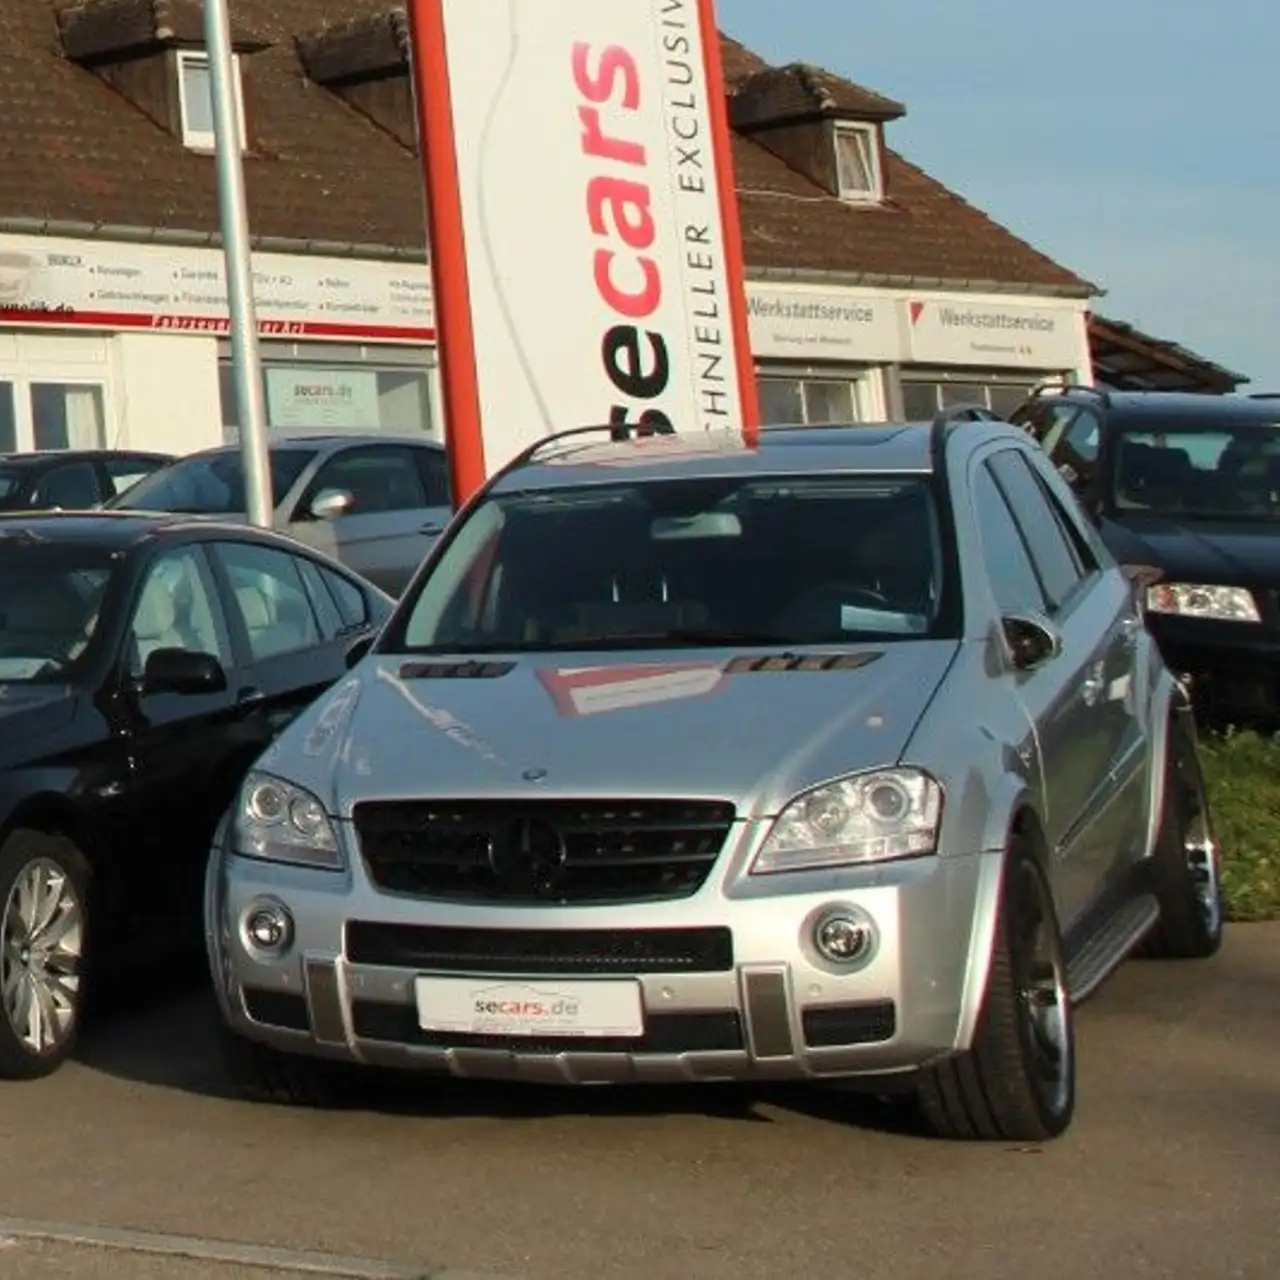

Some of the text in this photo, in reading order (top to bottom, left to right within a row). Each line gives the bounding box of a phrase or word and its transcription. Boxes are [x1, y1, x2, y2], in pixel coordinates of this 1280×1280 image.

[747, 296, 874, 324] Werkstattservice
[940, 308, 1055, 332] Werkstattservice
[475, 997, 580, 1017] secars.de
